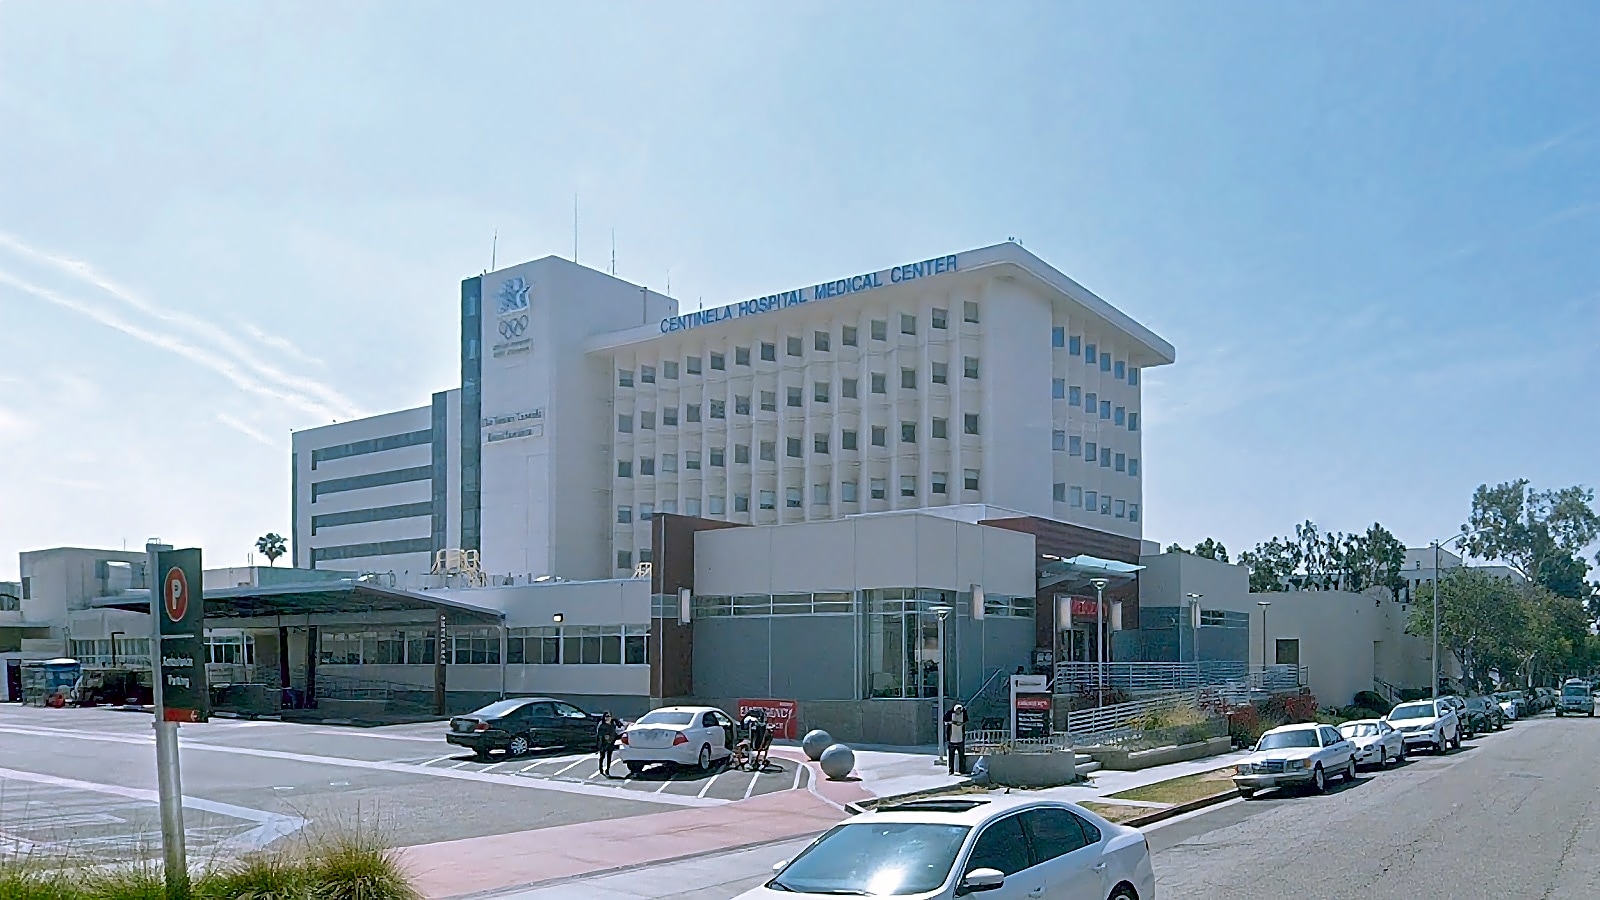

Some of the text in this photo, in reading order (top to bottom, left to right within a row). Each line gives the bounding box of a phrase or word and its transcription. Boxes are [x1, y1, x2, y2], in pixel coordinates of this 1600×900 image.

[661, 254, 957, 333] CENTINELA HOSPITAL MEDICAL CENTER
[171, 579, 182, 610] P
